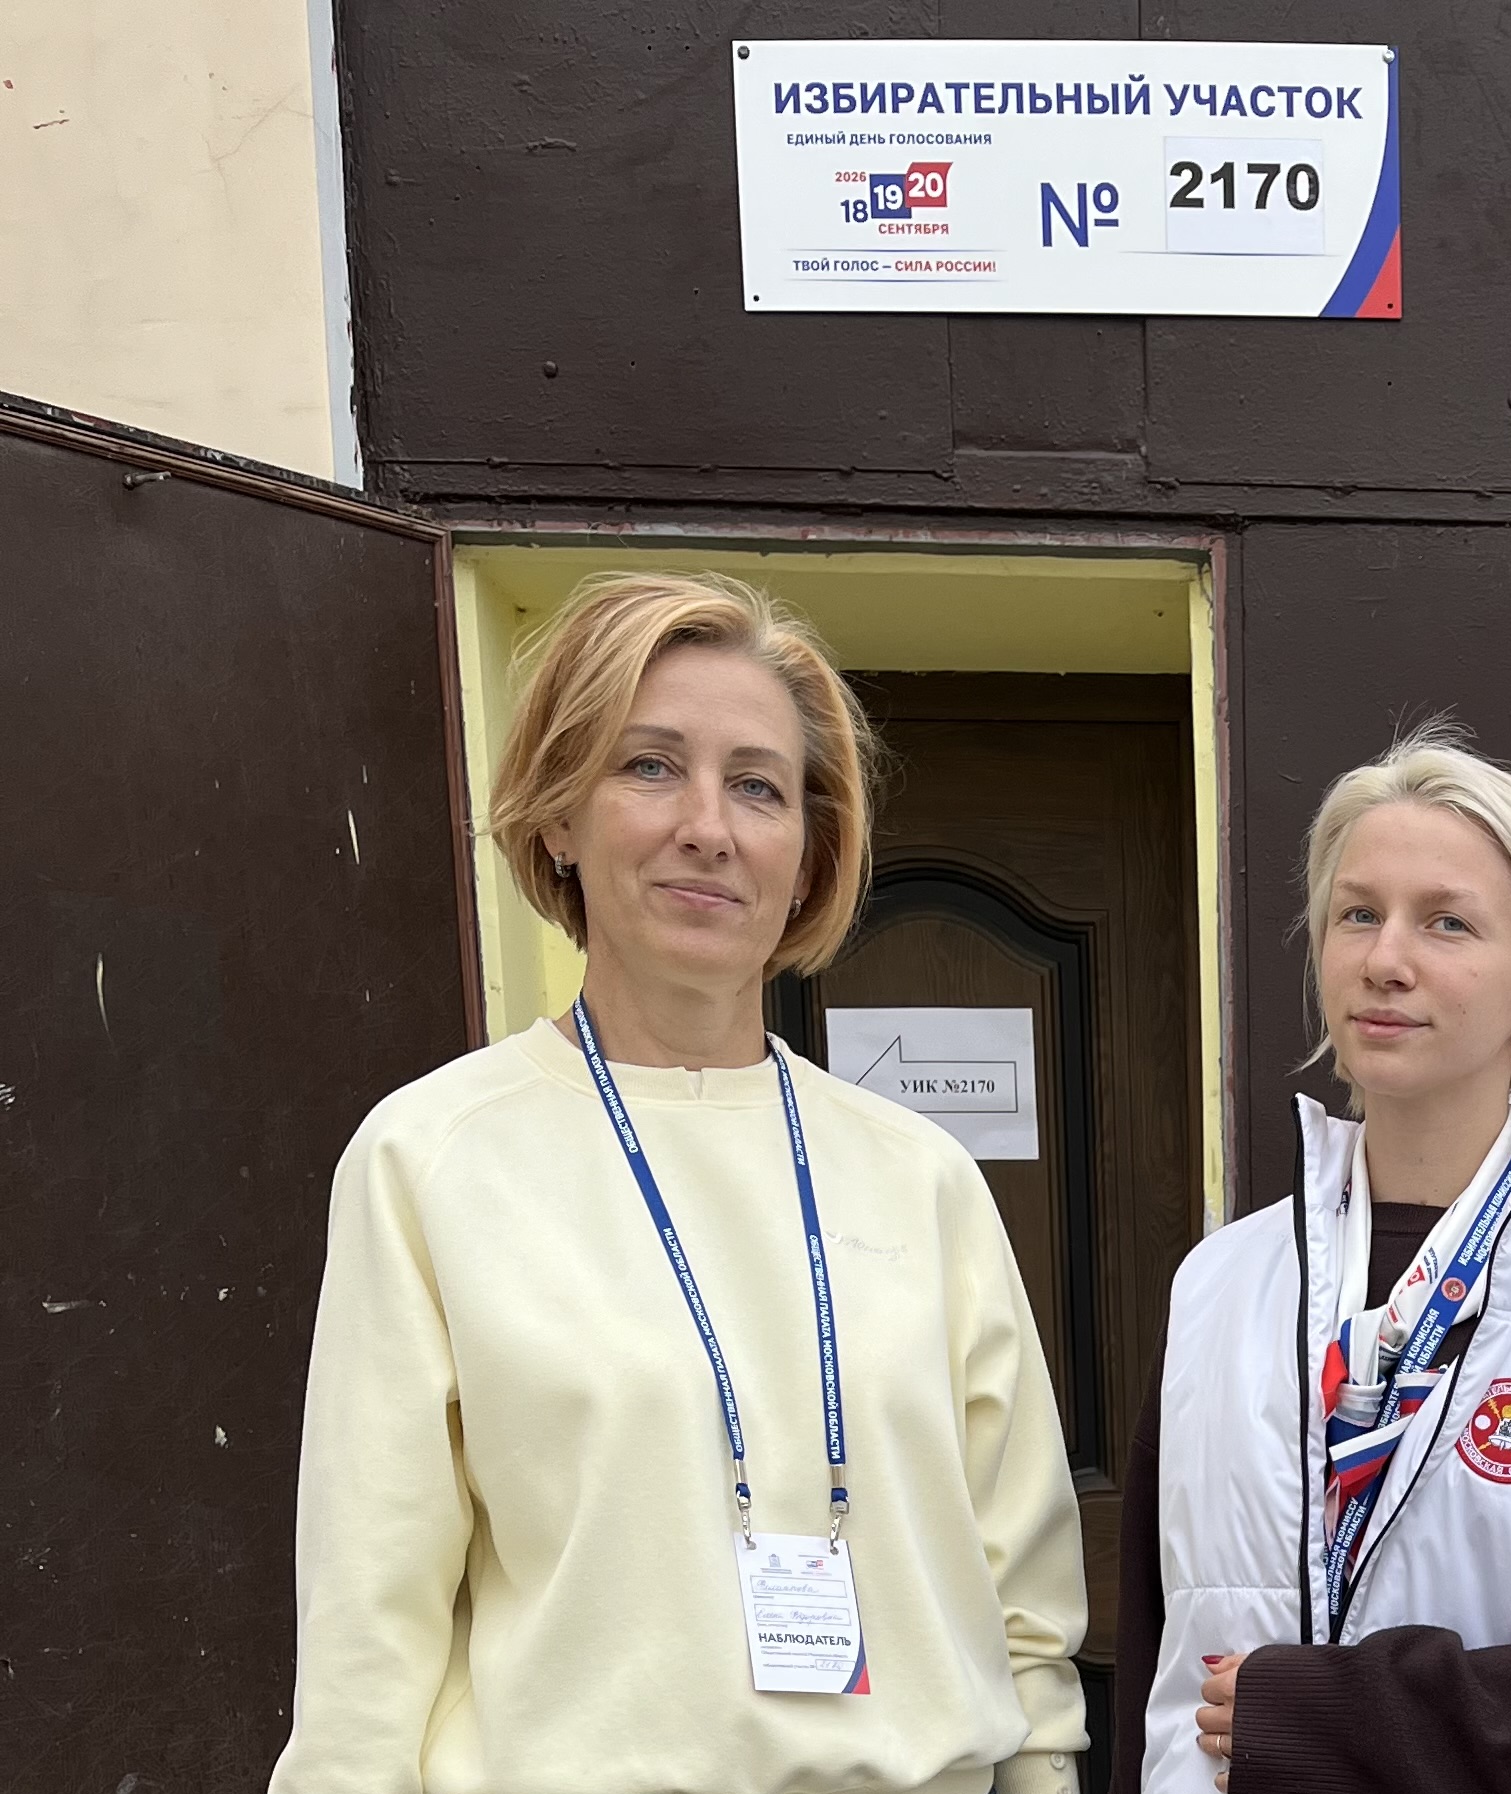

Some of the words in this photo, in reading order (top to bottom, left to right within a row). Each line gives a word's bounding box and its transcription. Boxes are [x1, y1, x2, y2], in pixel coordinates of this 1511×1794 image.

[773, 74, 1151, 117] ИЗБИРАТЕЛЬНЫЙ
[1163, 82, 1363, 119] УЧАСТОК
[786, 131, 846, 146] ЕДИНЫЙ
[849, 133, 886, 146] ДЕНЬ
[889, 133, 992, 145] ГОЛОСОВАНИЯ
[834, 171, 867, 182] 2026
[840, 199, 868, 223] 18
[873, 184, 904, 210] 19
[907, 171, 944, 198] 20
[1040, 181, 1120, 248] №
[1168, 161, 1321, 212] 2170
[878, 223, 949, 235] СЕНТЯБРЯ
[793, 258, 830, 272] ТВОЙ
[833, 260, 879, 272] ГОЛОС
[895, 260, 933, 272] СИЛА
[936, 261, 997, 272] РОССИИ!
[590, 1053, 609, 1086] ПАЛАТА
[900, 1079, 938, 1094] УИК
[941, 1079, 996, 1094] №2170
[663, 1227, 686, 1271] ОБЛАСТИ
[1457, 1204, 1497, 1266] ИЗБИРАТЕЛЬНАЯ
[809, 1234, 828, 1302] ОБЩЕСТВЕННАЯ
[679, 1271, 712, 1336] МОСКОВСКОЙ
[819, 1302, 830, 1337] ПАЛАТА
[1406, 1307, 1439, 1359] КОМИССИЯ
[1417, 1322, 1445, 1366] ОБЛАСТИ
[706, 1337, 725, 1374] ПАЛАТА
[822, 1339, 838, 1409] МОСКОВСКОЙ
[719, 1373, 743, 1453] ОБЩЕСТВЕННАЯ
[828, 1410, 840, 1459] ОБЛАСТИ
[1329, 1548, 1347, 1613] МОСКОВСКОЙ
[1342, 1505, 1366, 1547] ОБЛАСТИ
[758, 1632, 852, 1646] НАБЛЮДАТЕЛЬ
